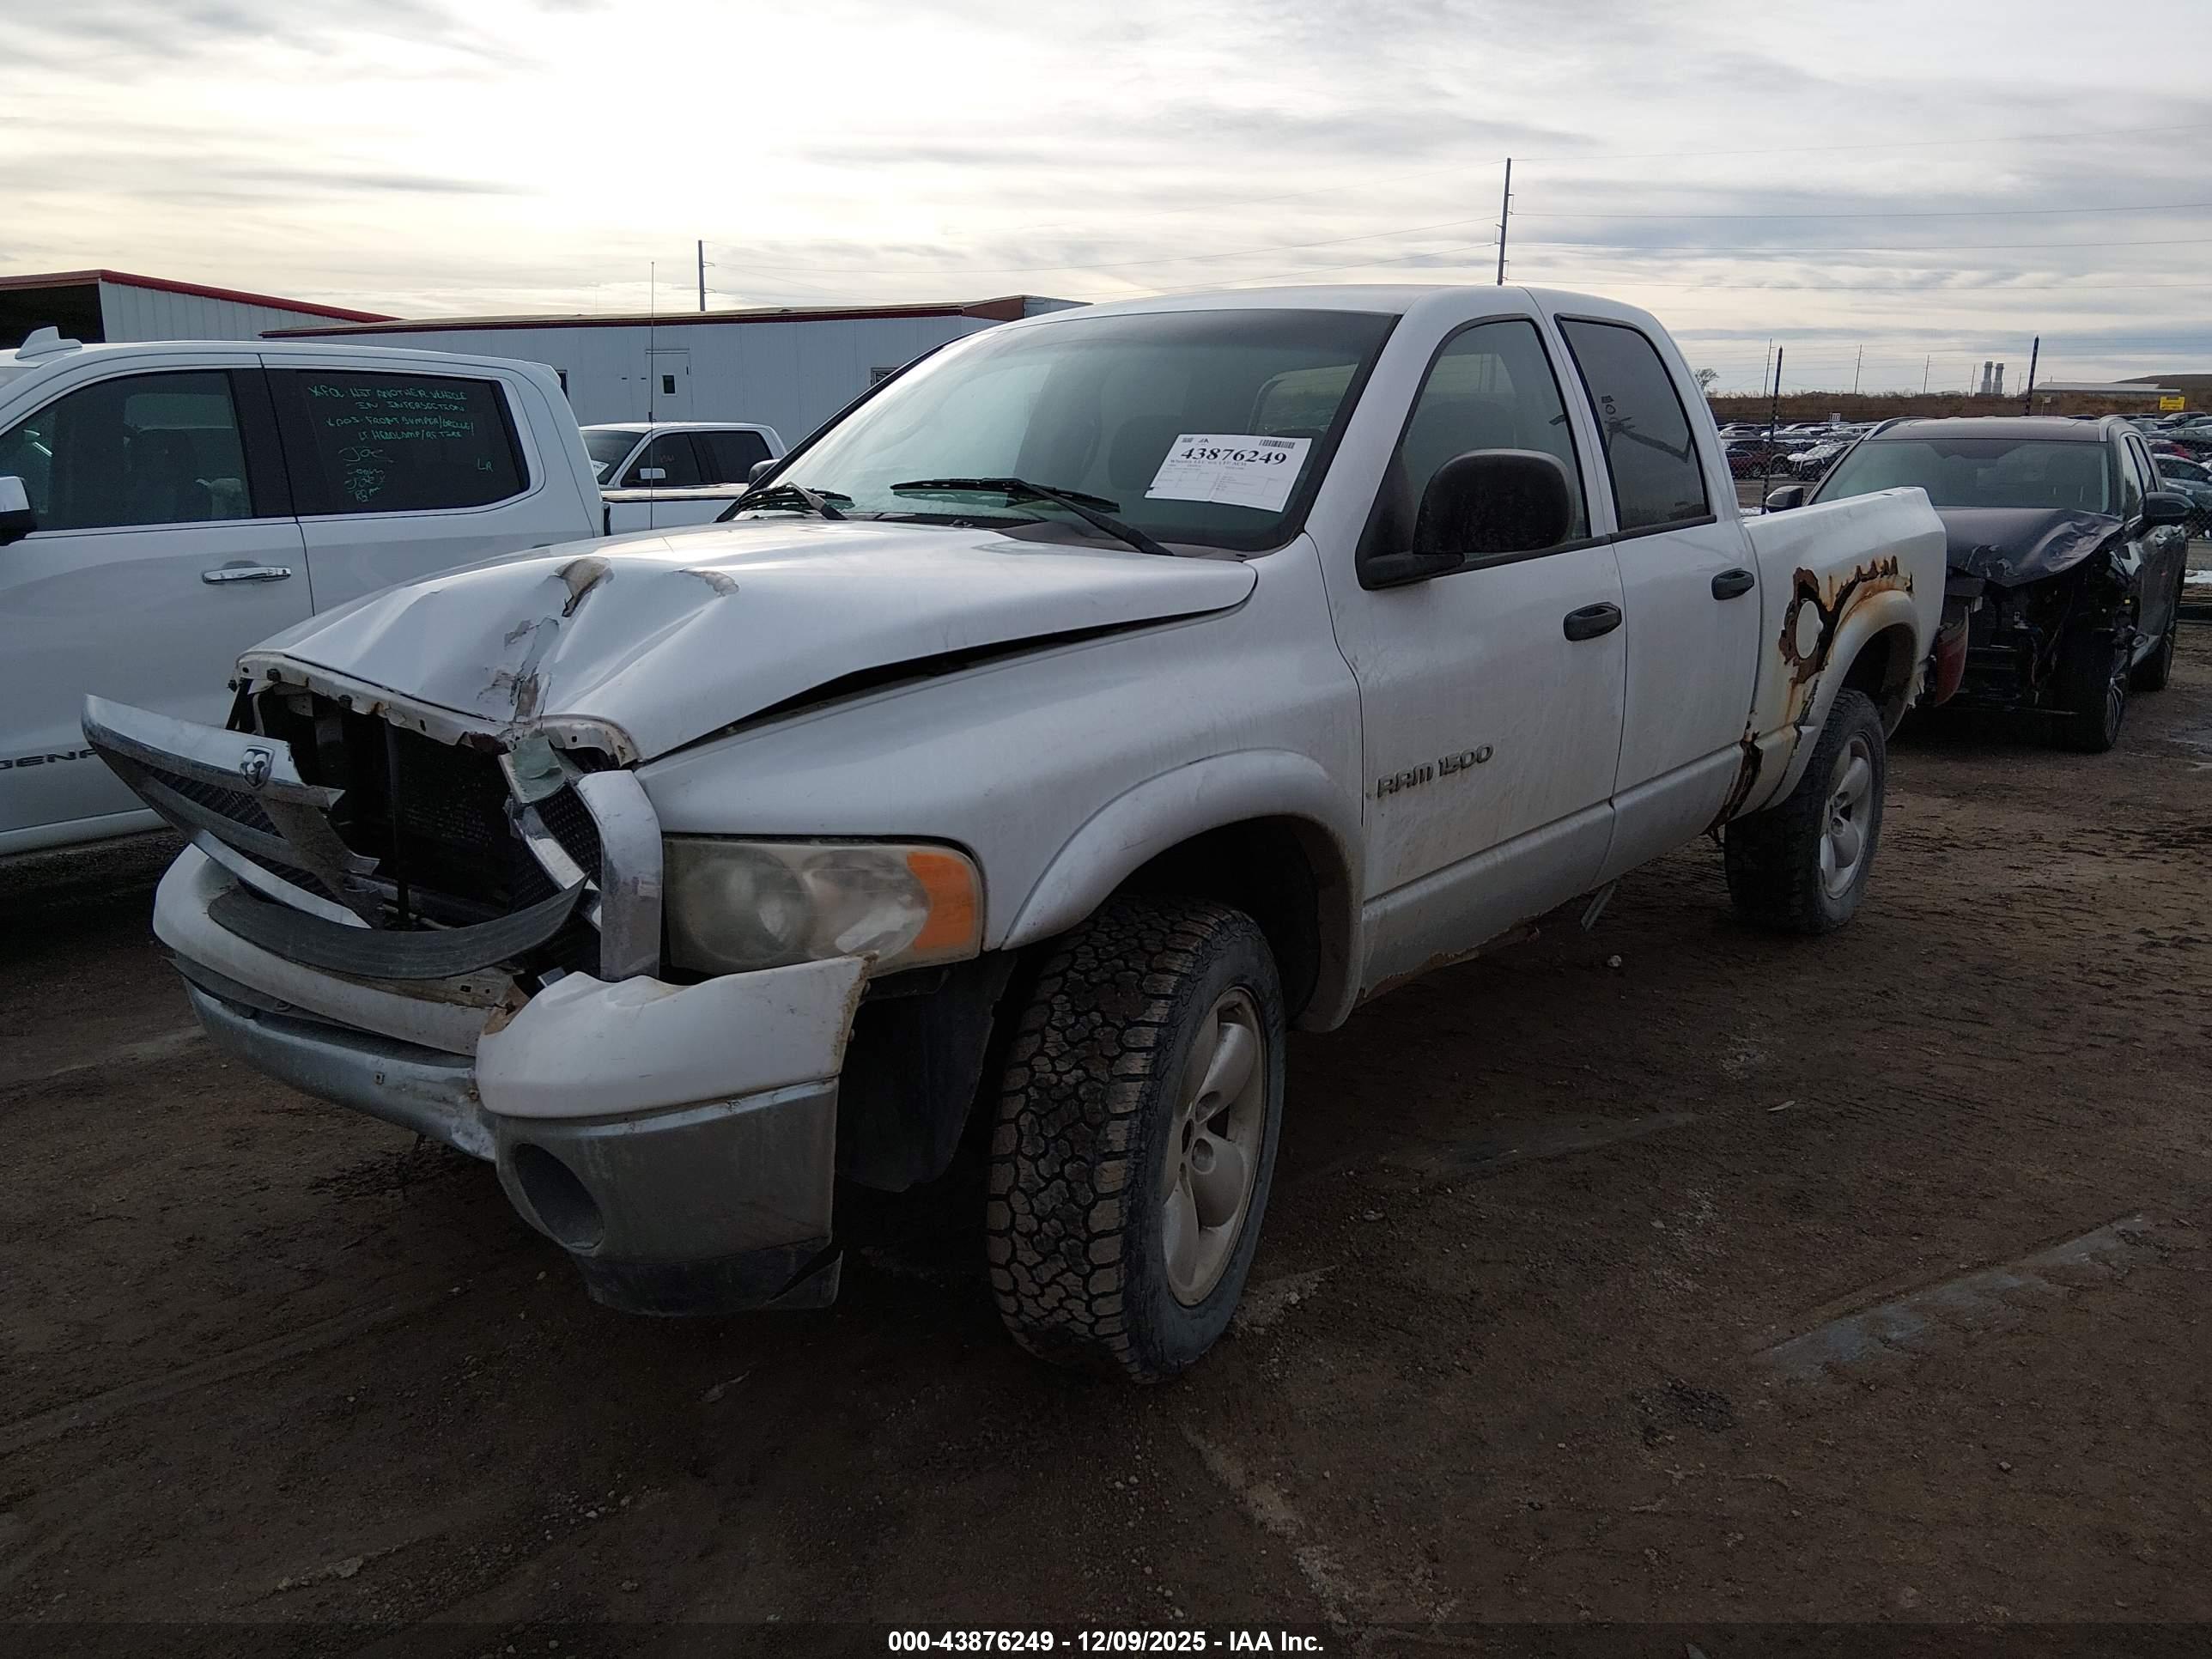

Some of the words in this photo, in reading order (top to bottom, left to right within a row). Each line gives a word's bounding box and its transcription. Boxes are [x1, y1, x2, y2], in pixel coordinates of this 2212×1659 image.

[376, 387, 429, 399] ANOTHER
[386, 401, 465, 412] INTERSECTION
[1181, 447, 1287, 465] 43876249
[1376, 762, 1434, 799] RAM
[1437, 743, 1494, 777] 1500
